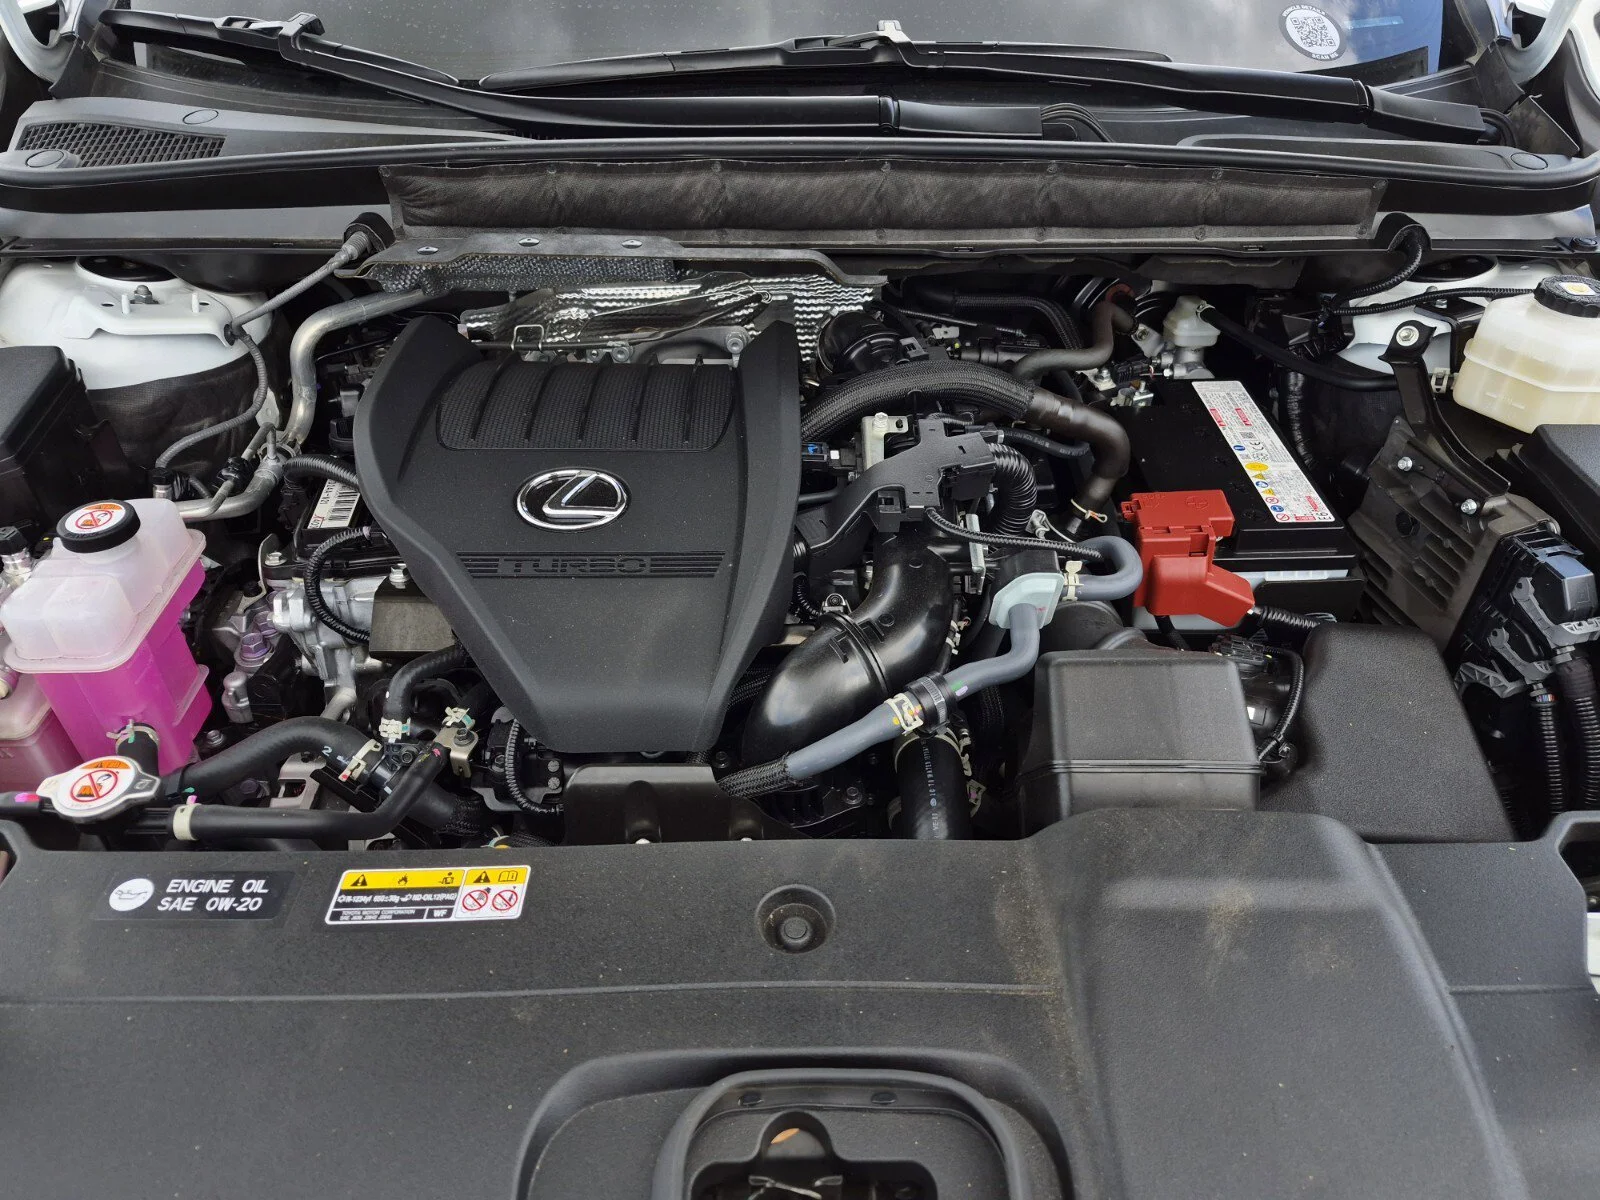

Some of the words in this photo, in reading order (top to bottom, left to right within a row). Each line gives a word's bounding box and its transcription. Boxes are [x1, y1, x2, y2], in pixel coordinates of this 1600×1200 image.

[1282, 4, 1300, 17] VEHICLE
[1301, 4, 1326, 16] DETAILS
[1329, 51, 1339, 59] ME
[503, 557, 646, 573] TURBO
[165, 879, 235, 893] ENGINE
[241, 879, 270, 894] OIL
[157, 897, 198, 912] SAE
[205, 897, 263, 912] 0W-20
